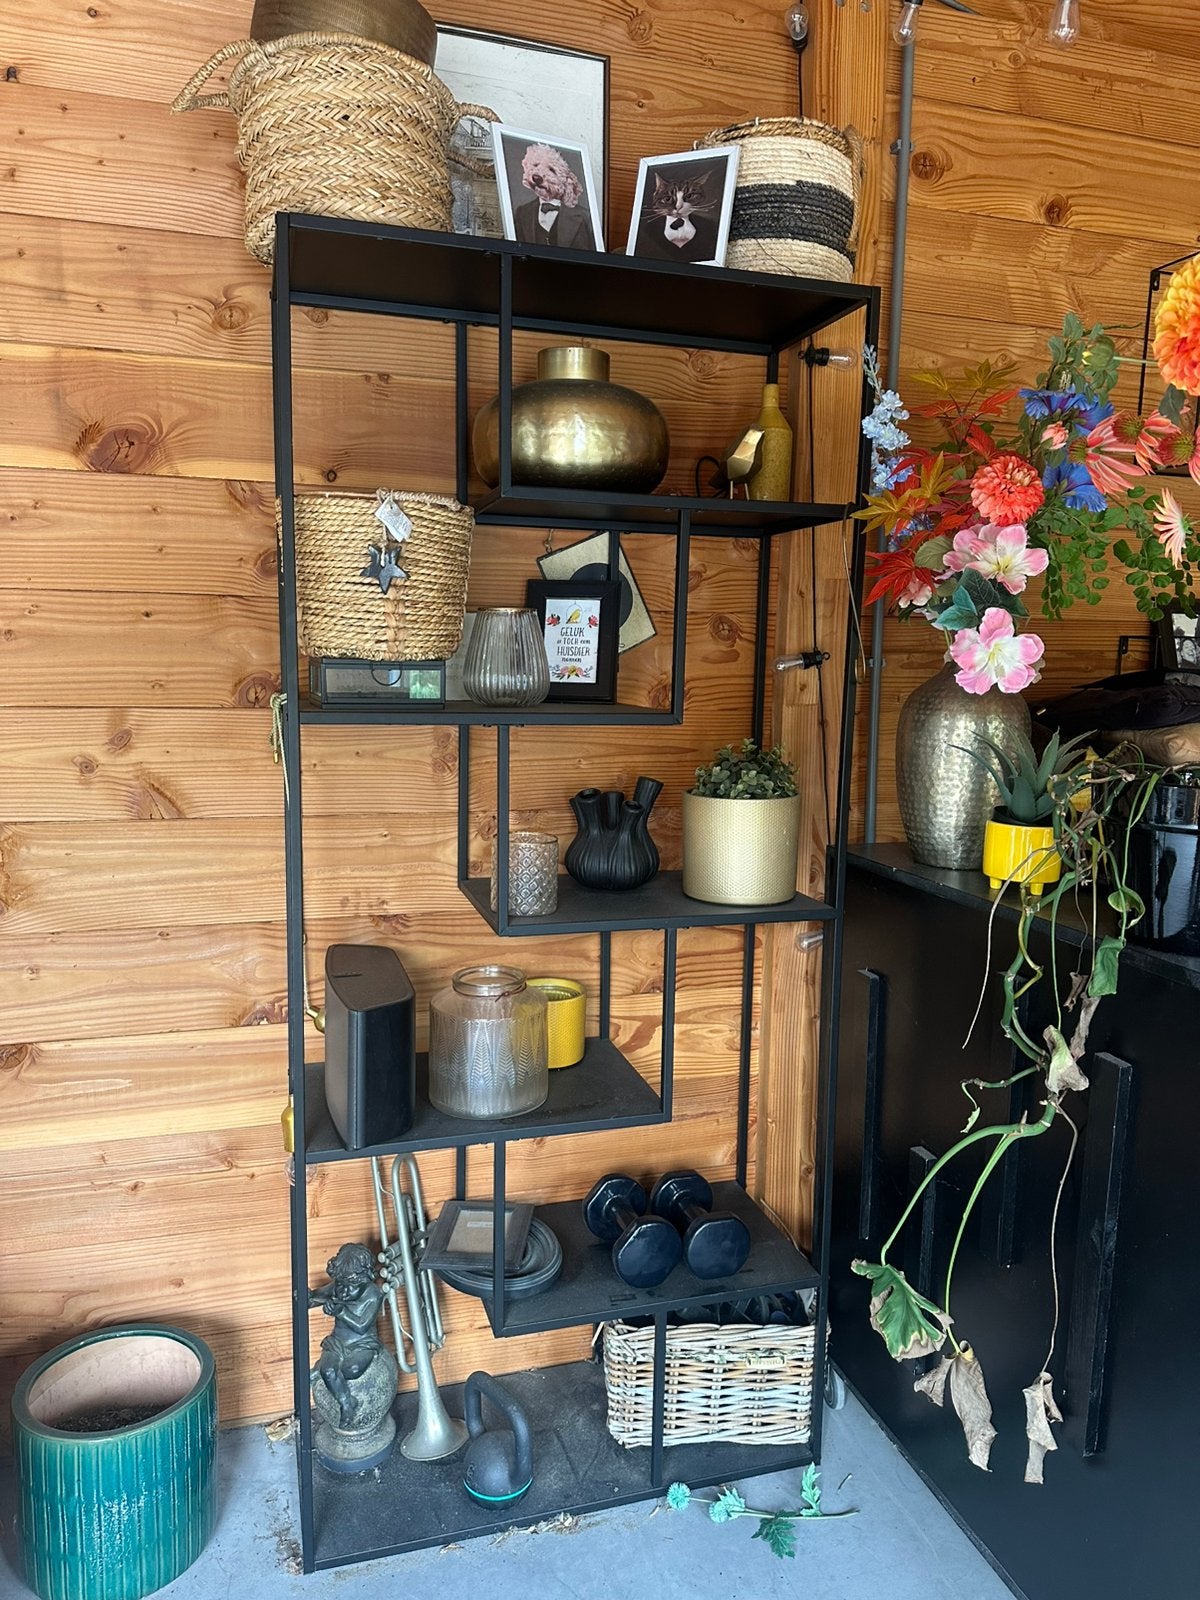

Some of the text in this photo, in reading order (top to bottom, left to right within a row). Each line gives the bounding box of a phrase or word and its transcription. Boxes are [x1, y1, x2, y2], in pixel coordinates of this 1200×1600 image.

[561, 627, 585, 637] GELUK
[563, 637, 578, 645] TOCH
[557, 646, 590, 656] HUISDIER
